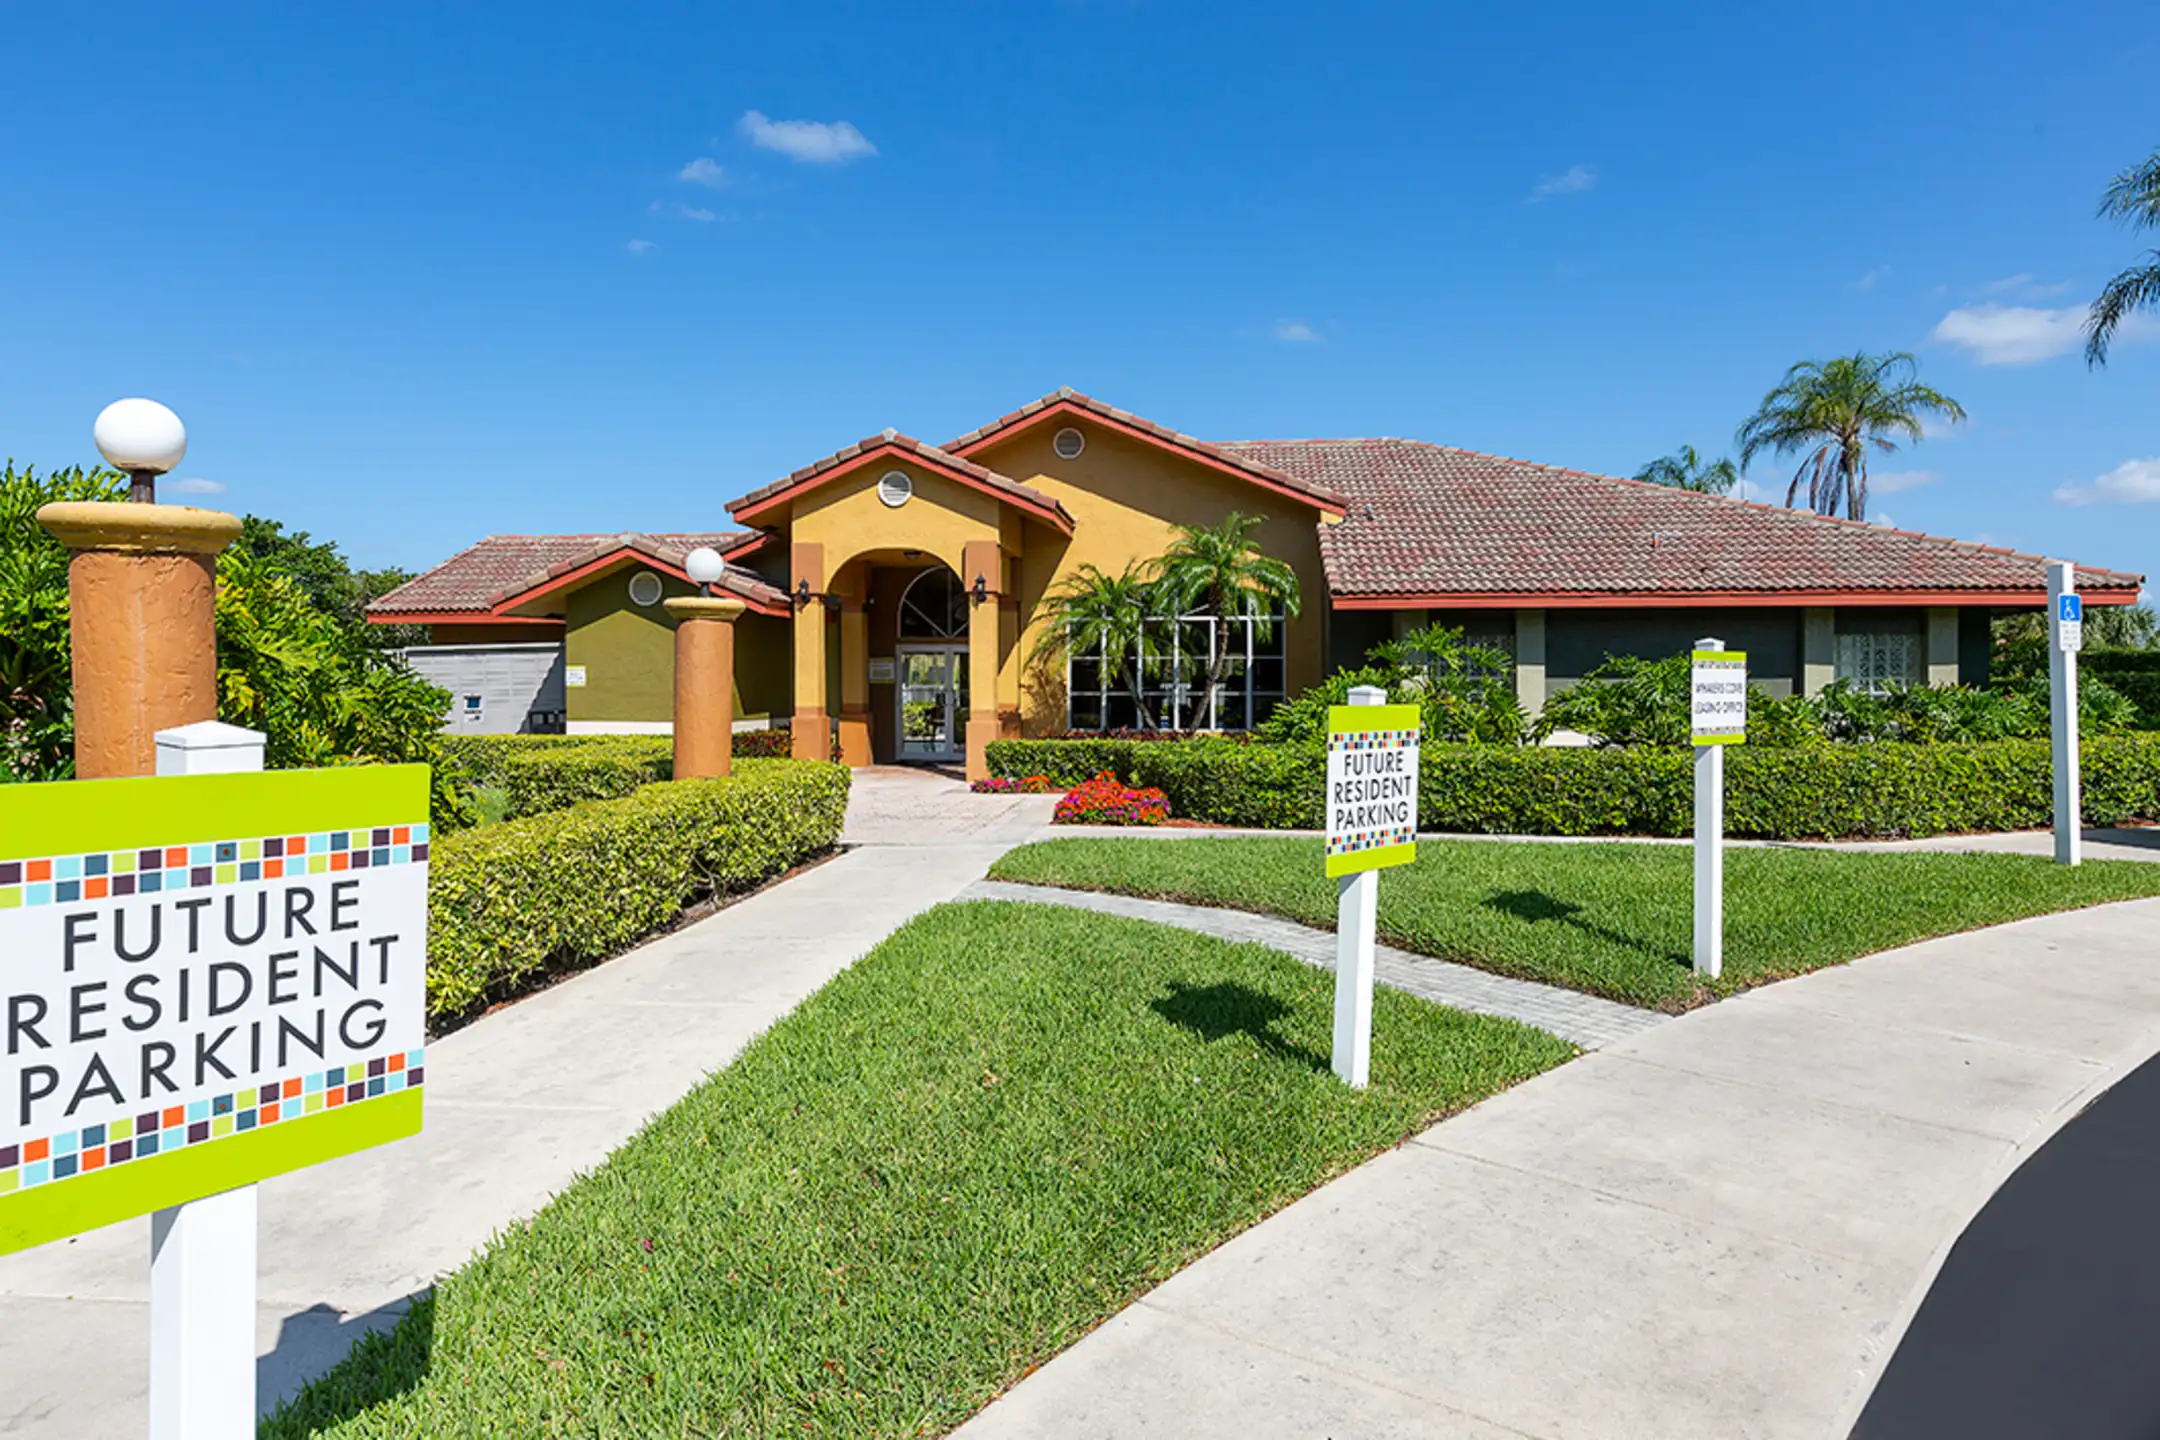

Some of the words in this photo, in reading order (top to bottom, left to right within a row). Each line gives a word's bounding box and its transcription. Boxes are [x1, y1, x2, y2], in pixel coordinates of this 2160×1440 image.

[1334, 776, 1412, 805] RESIDENT
[1344, 751, 1404, 776] FUTURE
[1336, 801, 1409, 831] PARKING
[63, 879, 360, 972] FUTURE
[7, 934, 400, 1056] RESIDENT
[19, 998, 388, 1127] PARKING
